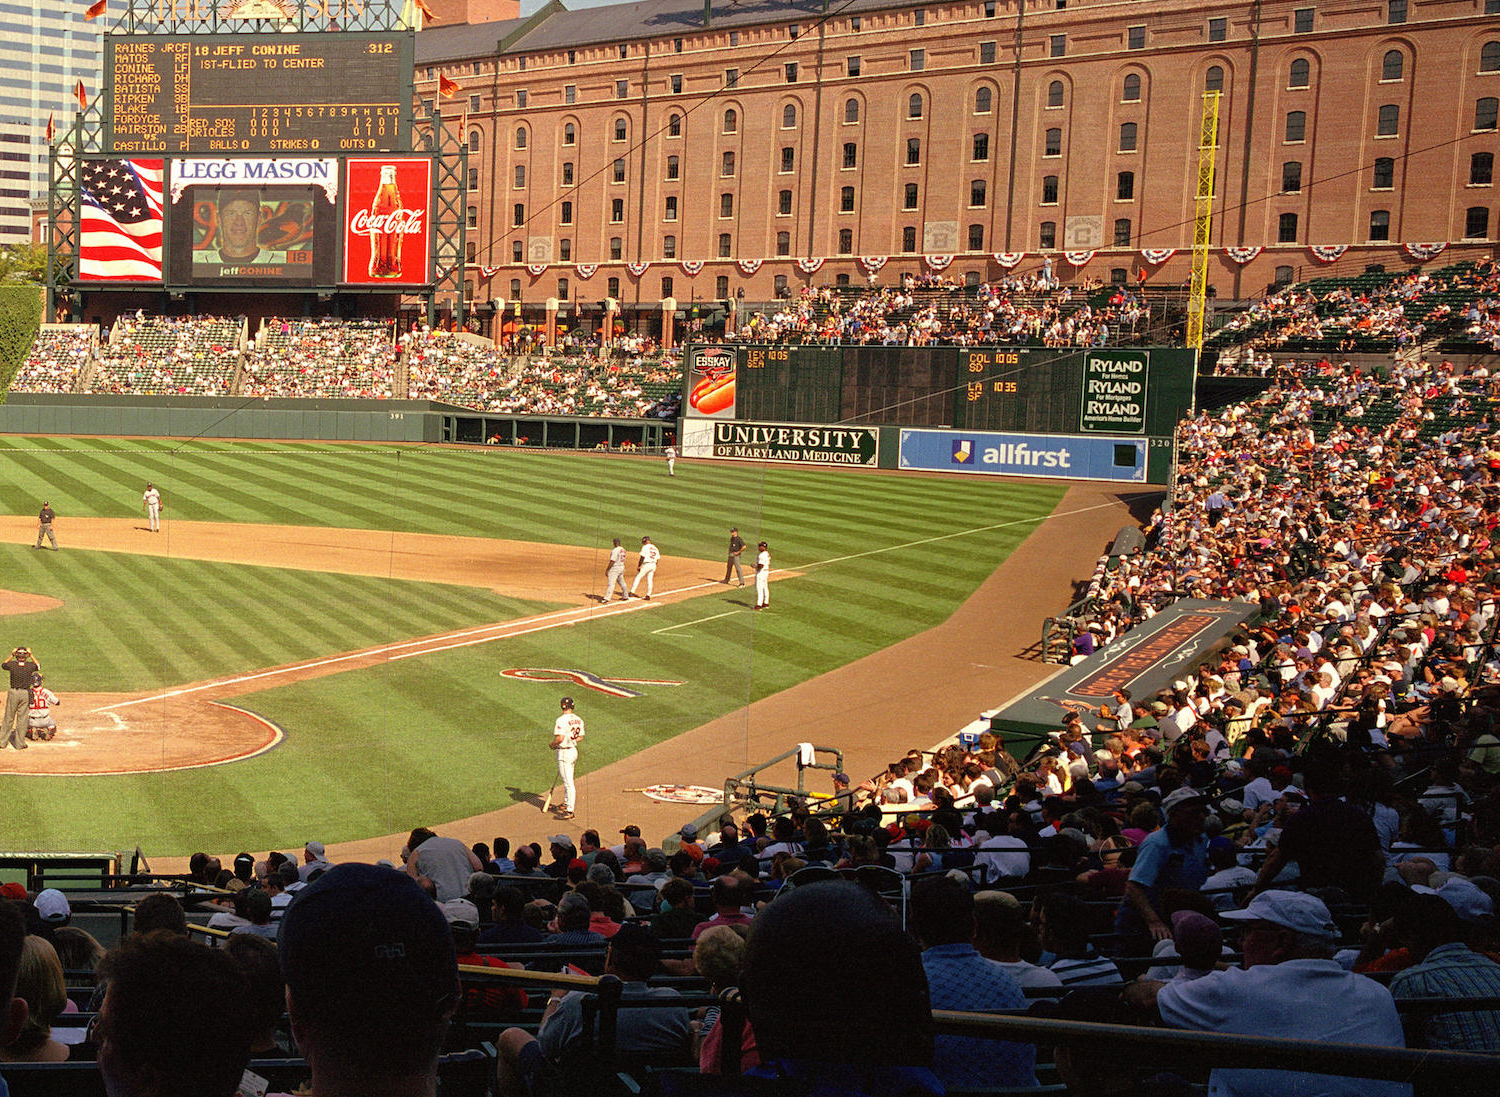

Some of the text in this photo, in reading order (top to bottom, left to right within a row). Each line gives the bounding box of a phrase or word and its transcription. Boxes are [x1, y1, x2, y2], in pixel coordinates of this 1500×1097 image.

[115, 44, 155, 53] RAINES
[195, 44, 393, 56] 18 JEFF CONINE .312
[115, 54, 188, 63] MATOS RF
[115, 64, 188, 73] CONINE LF
[264, 60, 277, 69] TO
[283, 59, 325, 68] CENTER
[115, 74, 188, 83] RICHARD DH
[115, 84, 188, 93] BATISTA SS
[114, 94, 188, 103] RIPKEN 3B
[114, 105, 188, 114] BLAKE 1B
[114, 114, 187, 124] FORDYCE C
[190, 119, 209, 127] RED
[214, 119, 235, 127] SOX
[114, 125, 187, 134] HAIRSTON 2B
[189, 128, 235, 137] ORIOLES
[114, 142, 187, 151] CASTILLO P
[210, 139, 376, 150] BALLS 0 STRIKES 0 OUTS 0
[179, 161, 330, 179] LEGG MASON
[350, 209, 425, 236] Coca-Cola
[697, 357, 730, 367] ESSKAY
[970, 354, 990, 363] COL
[747, 360, 765, 368] SEA
[969, 363, 983, 373] SD
[1090, 359, 1143, 373] RYLAND
[968, 382, 982, 391] LA
[1088, 380, 1142, 394] RYLAND
[968, 392, 982, 401] SF
[1105, 394, 1132, 402] Mortgages
[1087, 401, 1140, 415] RYLAND
[717, 424, 864, 449] UNIVERSITY
[1151, 440, 1170, 448] 320
[718, 446, 861, 464] OF MARYLAND MEDICINE
[983, 443, 1071, 468] allfirst
